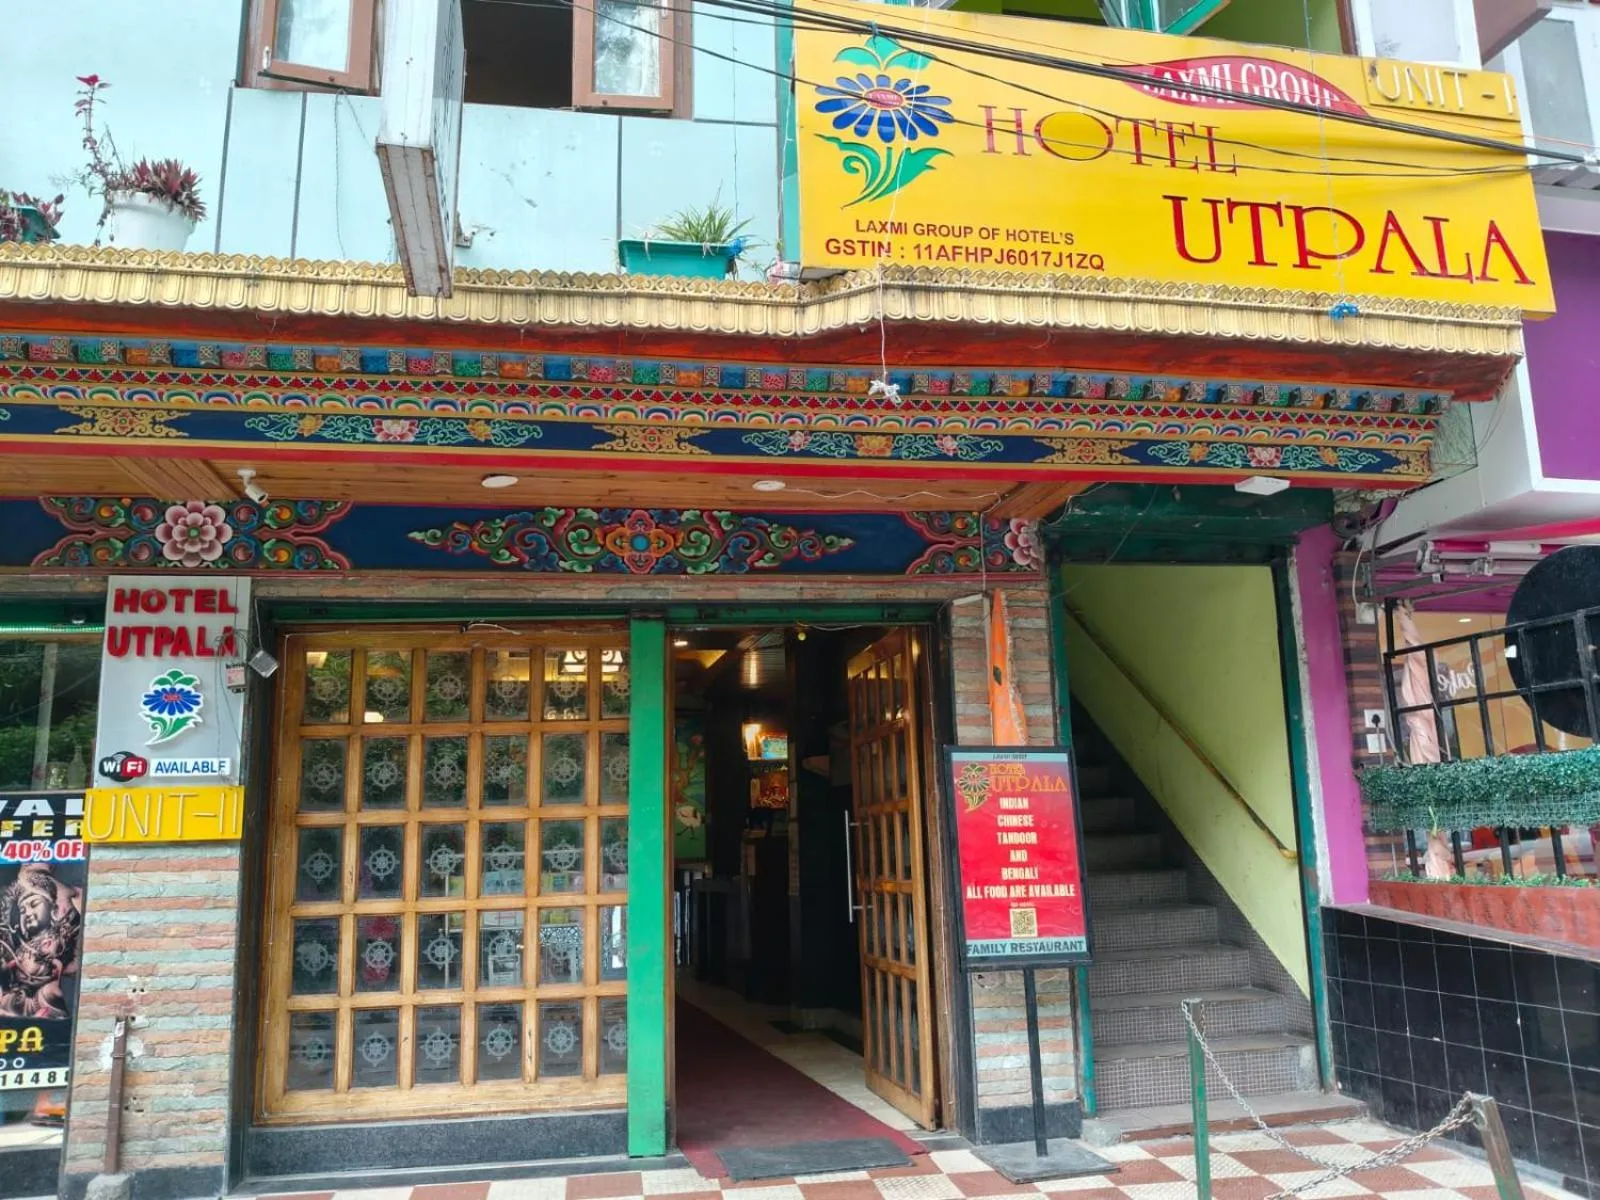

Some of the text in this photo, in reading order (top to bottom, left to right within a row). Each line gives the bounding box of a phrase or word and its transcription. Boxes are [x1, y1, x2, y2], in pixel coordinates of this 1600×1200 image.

[1371, 63, 1468, 110] UNIT
[978, 104, 1238, 177] HOTEL
[855, 219, 1075, 246] LAXMI GROUP OF HOTEL'S
[1162, 194, 1536, 285] UTPALA
[825, 238, 892, 258] GSTIN
[913, 243, 1105, 272] 11AFHPJ6017J1ZQ
[113, 588, 239, 614] HOTEL
[107, 625, 239, 658] UTPALA
[999, 797, 1029, 810] INDIAN
[997, 814, 1035, 828] CHINESE
[997, 831, 1038, 845] TANDOOR
[1009, 849, 1028, 862] AND
[1001, 866, 1039, 880] BENGALI
[966, 883, 1075, 899] ALL FOOD ARE AVAILABLE
[967, 940, 1084, 955] FAMILY RESTAURANT
